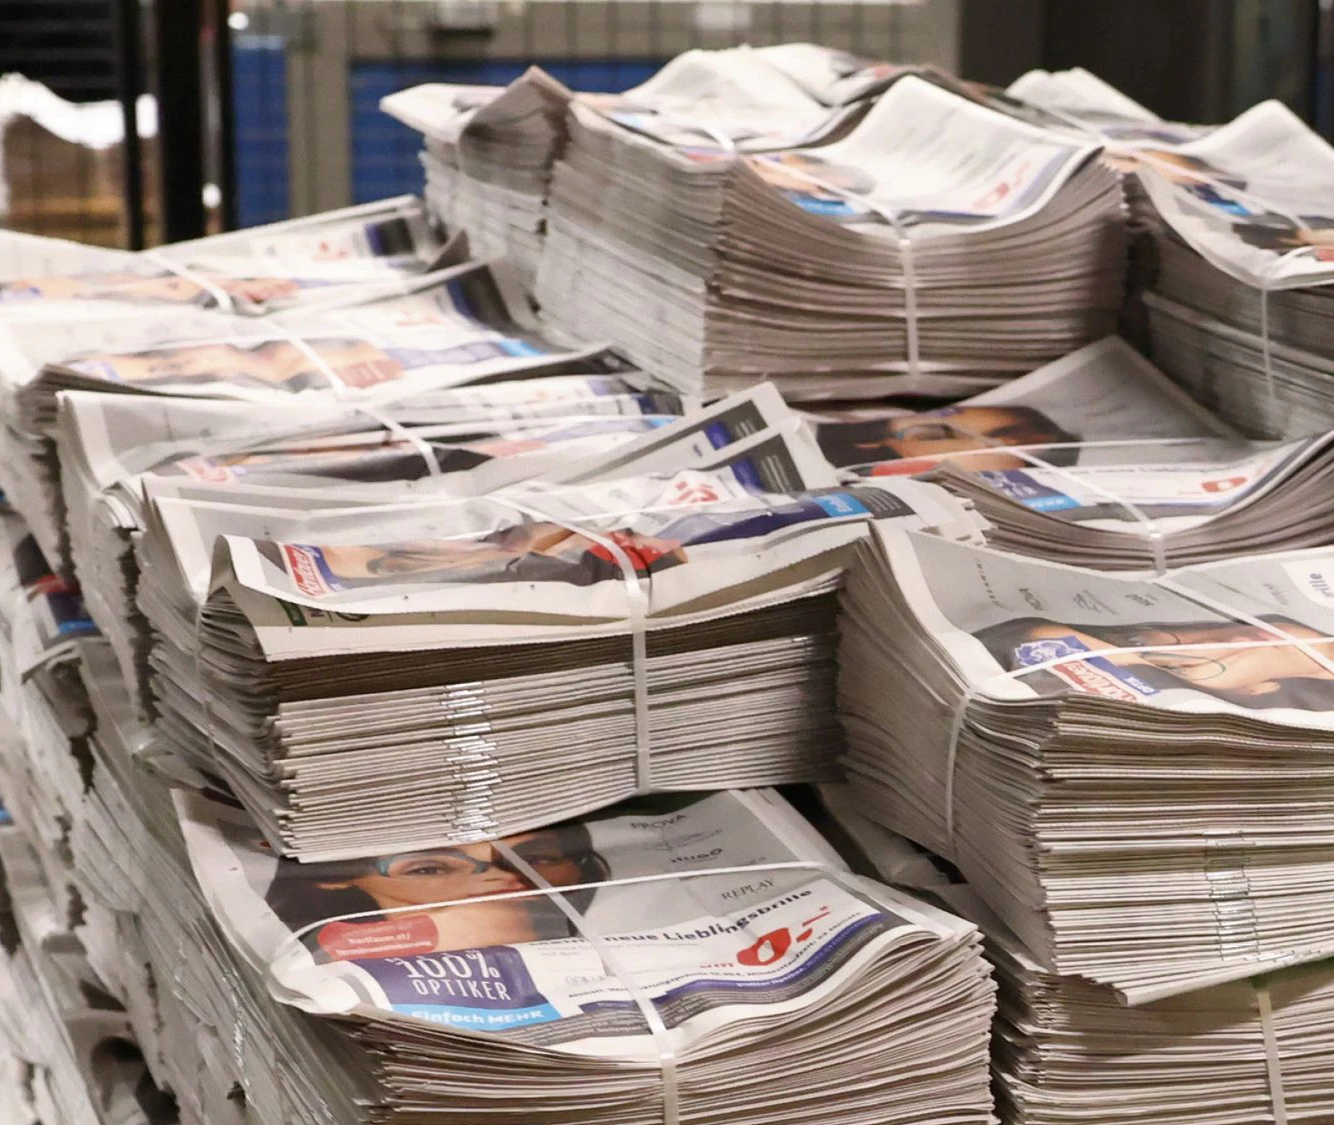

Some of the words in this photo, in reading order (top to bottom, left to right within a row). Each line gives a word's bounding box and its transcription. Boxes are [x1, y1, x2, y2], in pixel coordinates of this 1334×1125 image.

[722, 878, 774, 900] REPLAY
[664, 888, 813, 941] Lieblingsbrille
[411, 979, 512, 1001] OPTIKER
[487, 1010, 545, 1024] MEHR
